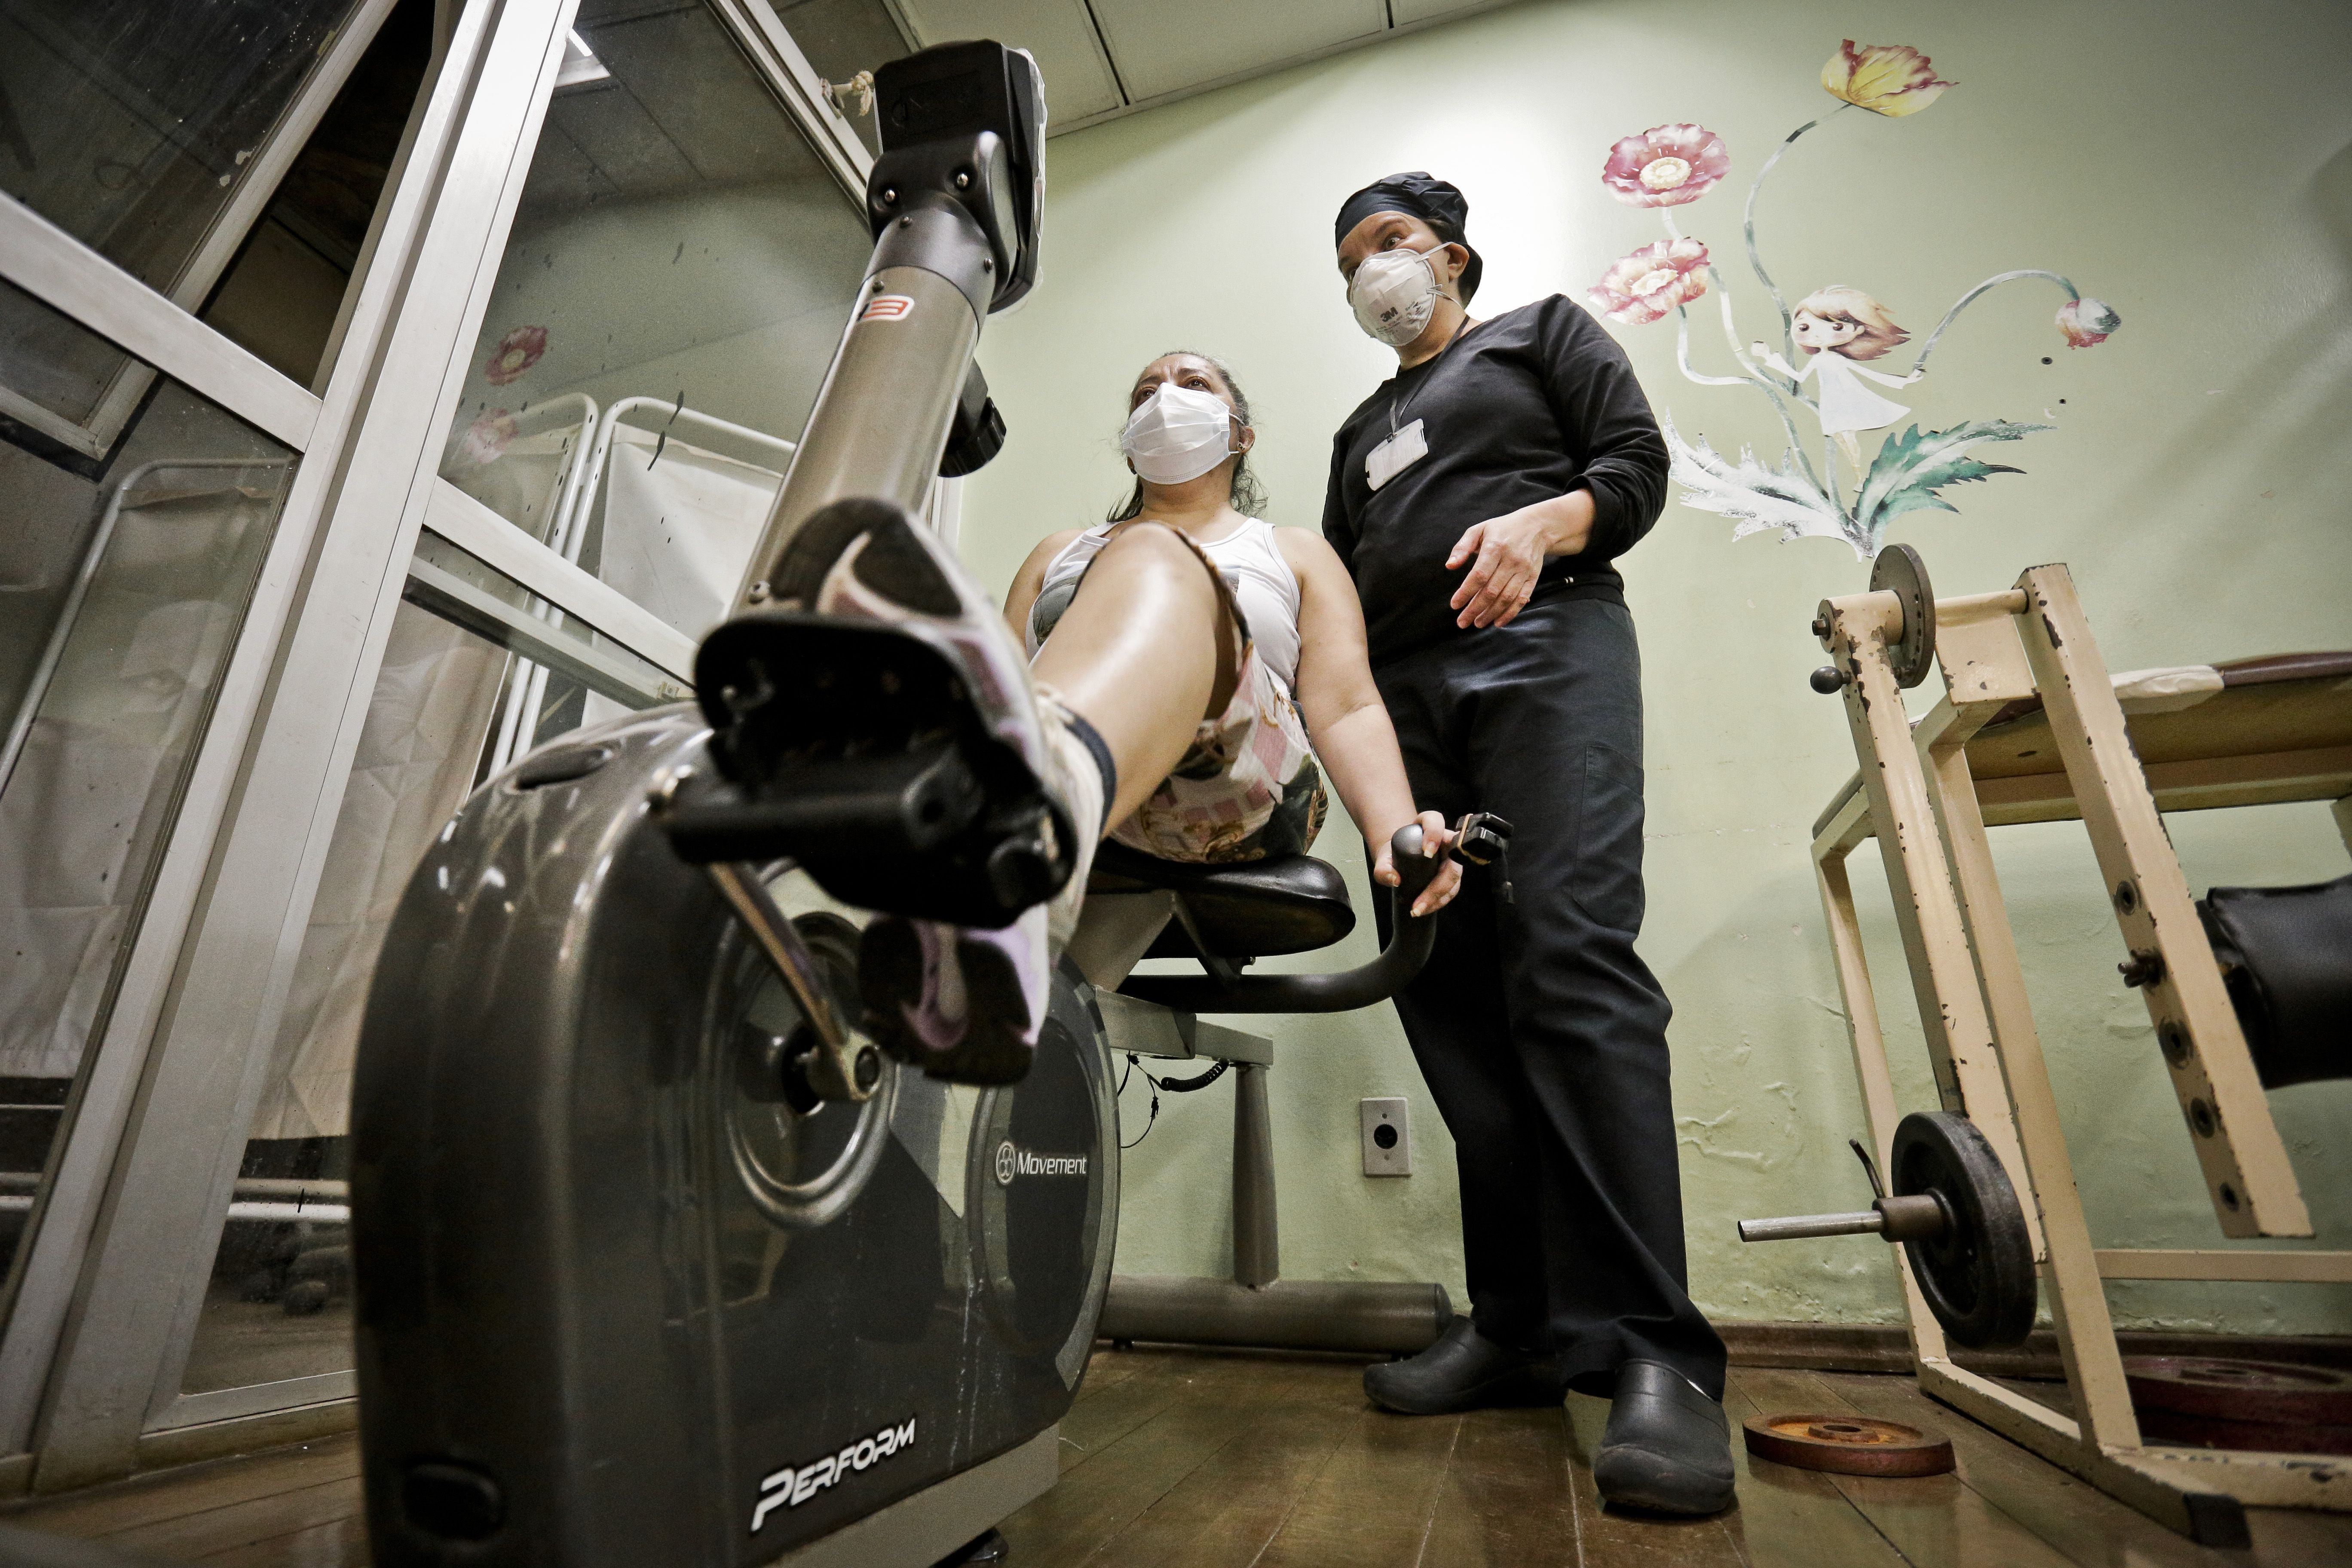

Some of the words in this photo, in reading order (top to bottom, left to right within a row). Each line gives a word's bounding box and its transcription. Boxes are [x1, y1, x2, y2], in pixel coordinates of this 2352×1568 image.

[1380, 306, 1398, 322] 3M
[1017, 1152, 1087, 1174] Movement
[751, 1418, 916, 1531] PERFORM
